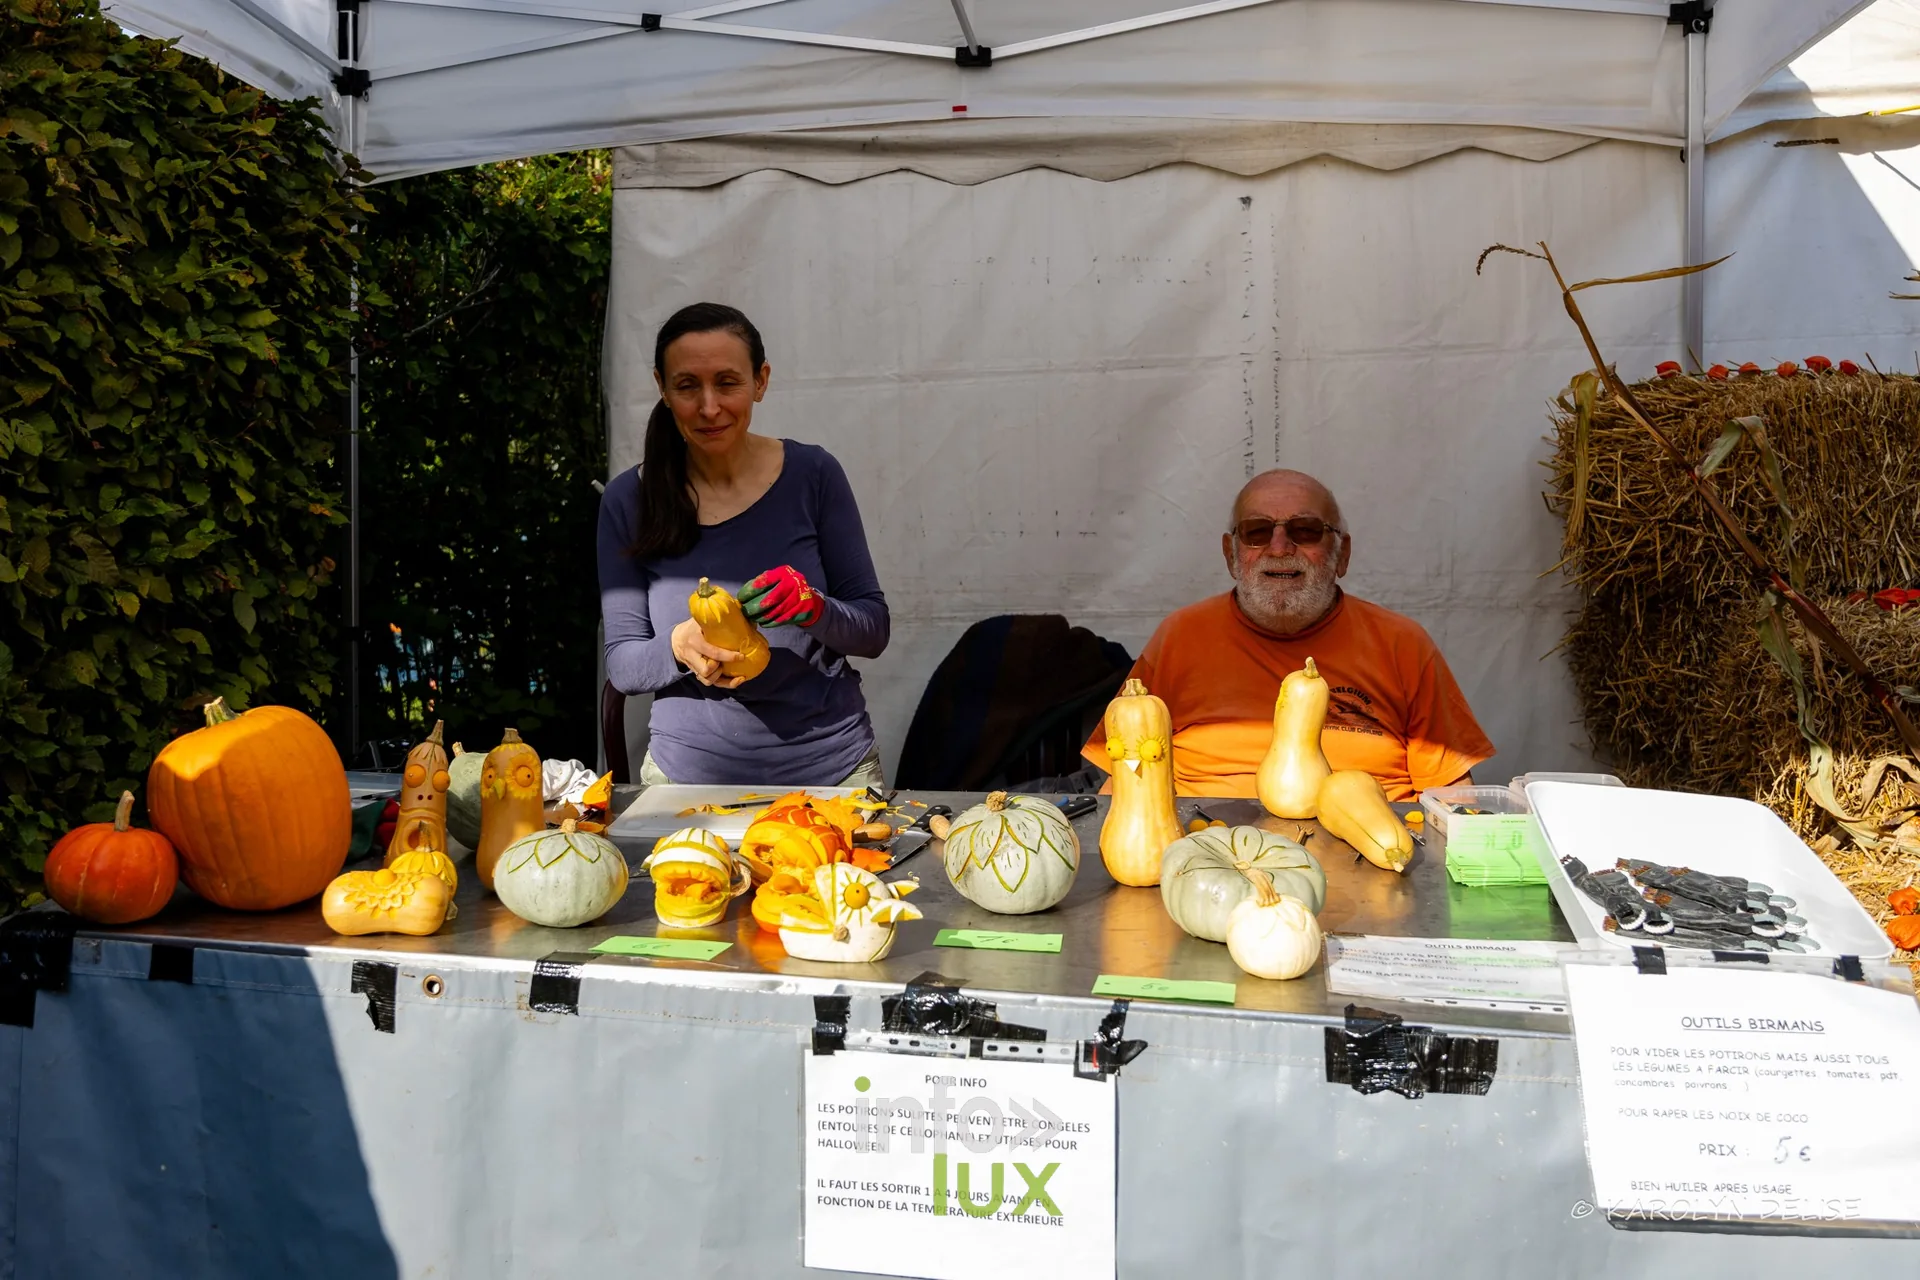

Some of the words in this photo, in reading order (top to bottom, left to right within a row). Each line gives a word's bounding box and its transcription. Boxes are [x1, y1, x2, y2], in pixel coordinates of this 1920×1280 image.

[1329, 686, 1372, 705] BELGIUM
[1681, 1016, 1742, 1030] OUTILS
[1748, 1018, 1825, 1033] BIRMANS
[1610, 1046, 1640, 1057] POUR
[1644, 1047, 1680, 1058] VIDER
[1683, 1049, 1706, 1059] LES
[1709, 1050, 1771, 1061] POTIRONS
[1776, 1052, 1808, 1063] MAIS
[1813, 1054, 1851, 1064] AUSSI
[1855, 1055, 1890, 1065] TOUS
[1612, 1061, 1633, 1072] LES
[1637, 1063, 1691, 1074] LEGUMES
[1695, 1065, 1703, 1073] A
[925, 1075, 957, 1087] POUR
[960, 1077, 988, 1089] INFO
[817, 1103, 835, 1114] LES
[838, 1104, 894, 1118] POTIRONS
[946, 1113, 999, 1126] PEUVENT
[1001, 1117, 1029, 1129] ETRE
[1031, 1119, 1091, 1134] CONGELES
[1618, 1107, 1649, 1118] POUR
[1652, 1109, 1689, 1119] RAPER
[1692, 1110, 1715, 1120] LES
[1719, 1111, 1751, 1121] NOIX
[1756, 1112, 1772, 1122] DE
[1776, 1113, 1809, 1123] COCO
[817, 1120, 879, 1135] (ENTOURES
[881, 1125, 897, 1135] DE
[978, 1134, 992, 1143] ET
[995, 1134, 1042, 1148] UTILISES
[1044, 1139, 1078, 1151] POUR
[817, 1138, 886, 1153] HALLOWEEN
[1698, 1143, 1738, 1157] PRIX
[817, 1178, 826, 1188] IL
[828, 1179, 858, 1191] FAUT
[860, 1181, 879, 1192] LES
[881, 1182, 921, 1196] SORTIR
[924, 1186, 931, 1196] 1
[934, 1188, 942, 1197] A
[944, 1189, 951, 1198] 4
[953, 1190, 990, 1203] JOURS
[993, 1193, 1033, 1206] AVANT
[1035, 1198, 1051, 1208] EN
[1630, 1181, 1661, 1191] BIEN
[1664, 1182, 1709, 1193] HUILER
[1713, 1184, 1749, 1193] APRES
[1753, 1185, 1793, 1195] USAGE
[817, 1195, 875, 1209] FONCTION
[877, 1199, 892, 1210] DE
[895, 1201, 909, 1212] LA
[911, 1202, 994, 1221] TEMPERATURE
[996, 1211, 1064, 1227] EXTERIEURE
